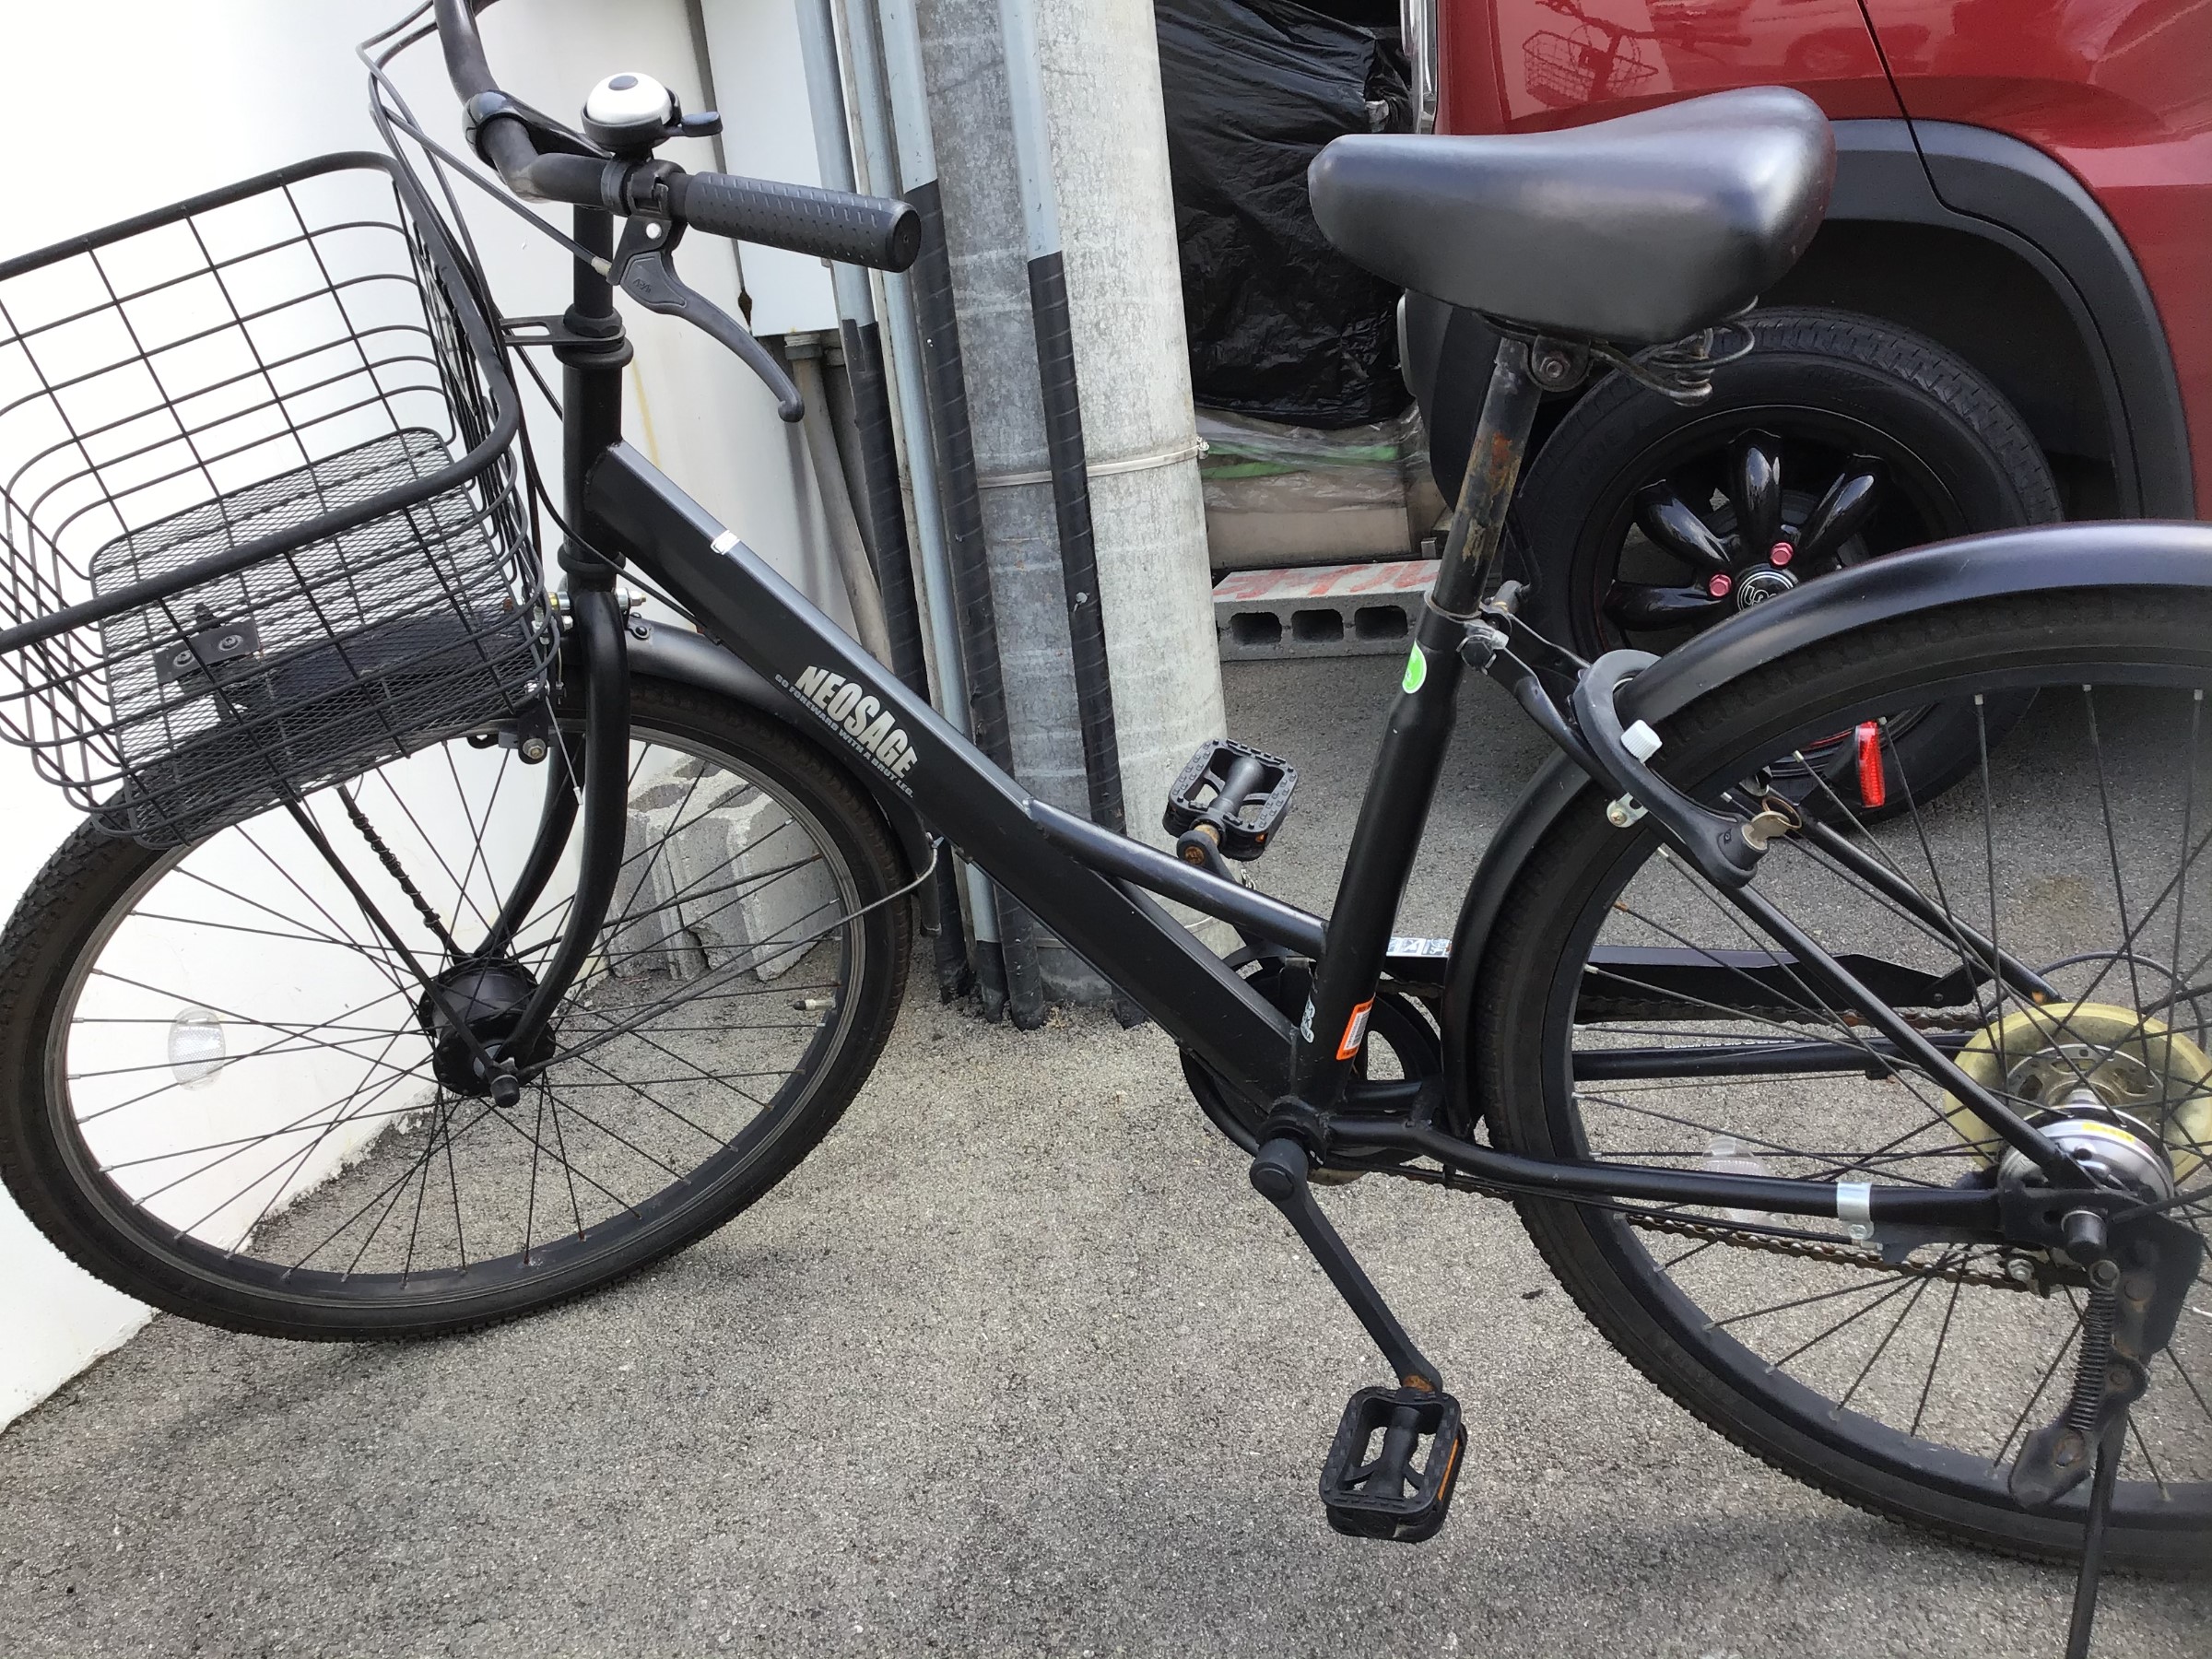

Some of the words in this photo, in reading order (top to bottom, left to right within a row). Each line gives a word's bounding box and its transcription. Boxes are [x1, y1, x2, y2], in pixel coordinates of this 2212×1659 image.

[794, 665, 918, 779] NEOSAGE
[839, 731, 864, 753] WITH
[864, 752, 871, 760] A
